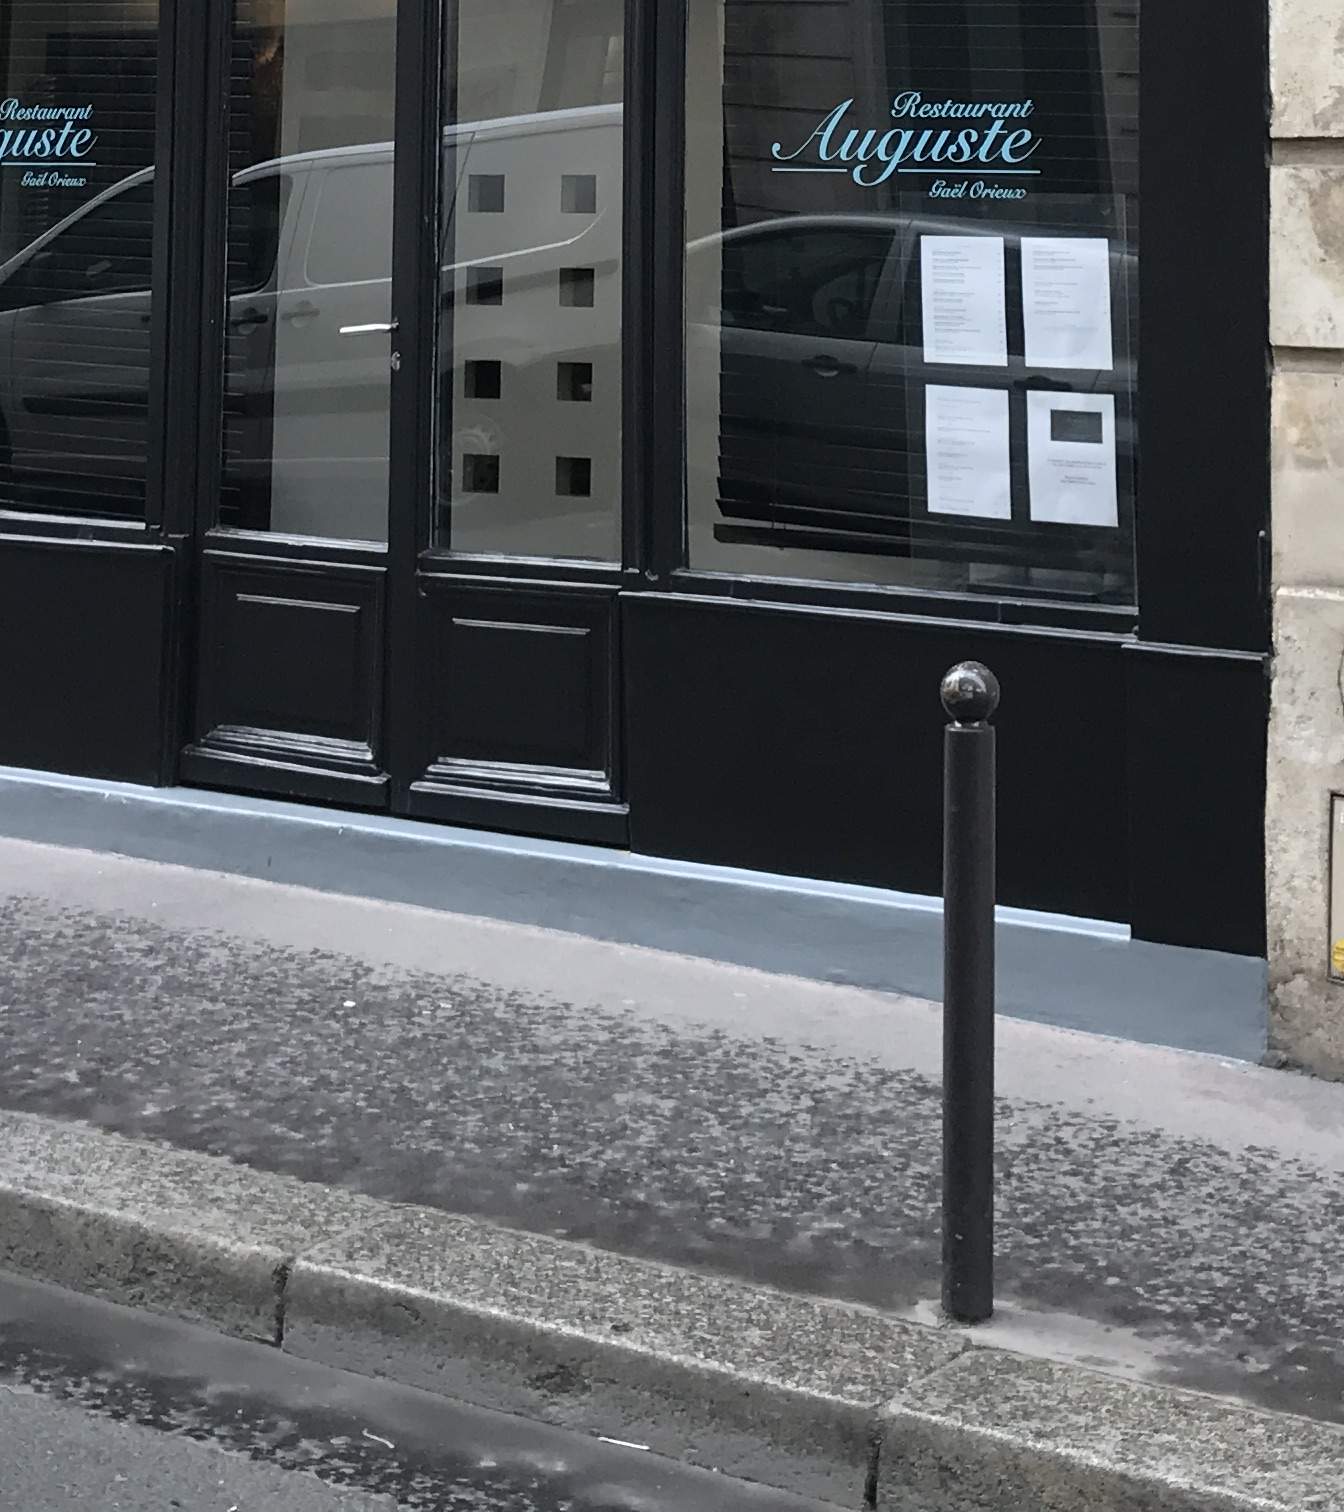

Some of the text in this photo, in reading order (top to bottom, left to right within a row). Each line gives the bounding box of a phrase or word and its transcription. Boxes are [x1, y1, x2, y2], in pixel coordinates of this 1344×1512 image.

[891, 90, 1035, 120] Restaurant
[771, 98, 1043, 187] Auguste
[21, 171, 87, 187] Gaël Orieux
[928, 179, 1027, 200] Gaël Orieux
